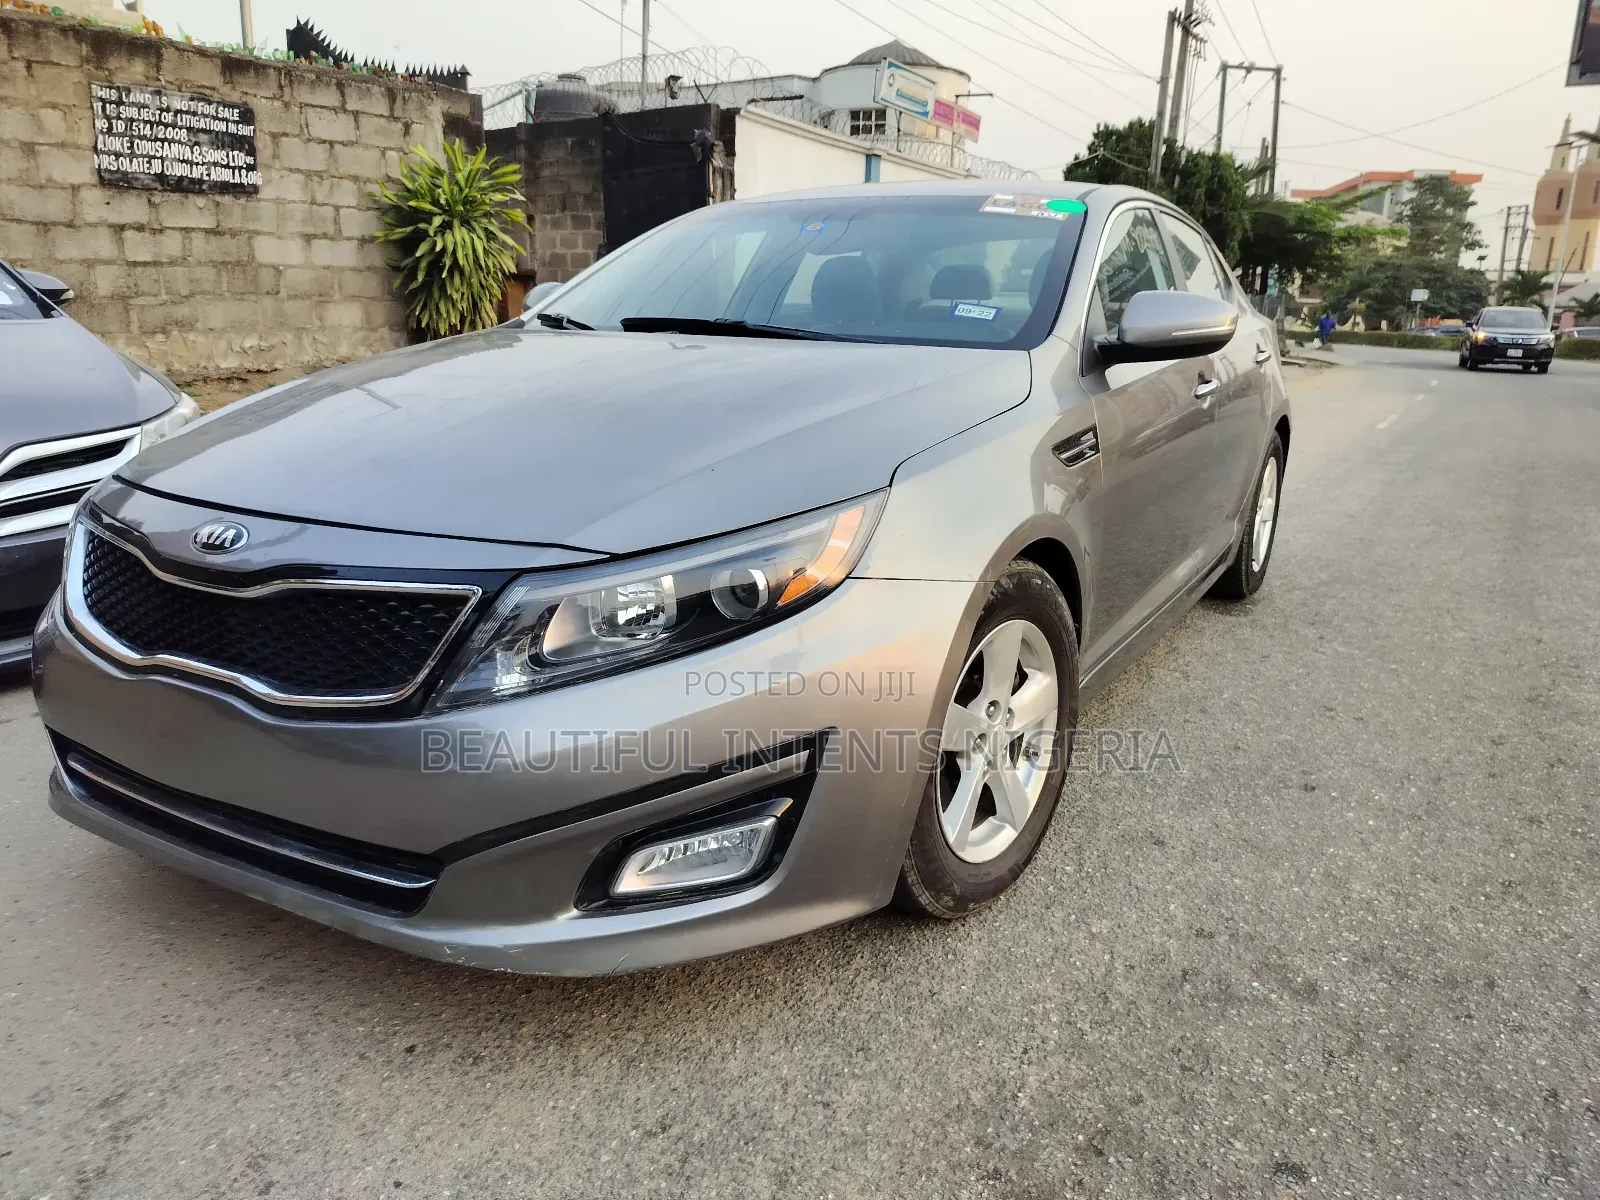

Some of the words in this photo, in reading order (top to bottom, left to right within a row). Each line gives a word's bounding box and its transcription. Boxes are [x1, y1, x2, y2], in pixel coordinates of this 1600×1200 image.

[91, 84, 118, 101] THIS
[122, 91, 153, 105] LAND
[198, 102, 217, 116] FOR
[217, 106, 240, 121] SALE
[93, 101, 103, 115] IT
[105, 103, 119, 117] IS
[119, 105, 160, 122] SUBJECT
[160, 111, 175, 124] OF
[177, 113, 227, 133] LITIGATION
[227, 121, 238, 134] IN
[237, 123, 255, 137] SUIT
[97, 133, 132, 154] AJOKE
[133, 138, 192, 161] ODUSANYA
[93, 153, 118, 171] MRS
[118, 156, 163, 174] OLATEJU
[163, 160, 209, 181] OJUOLAPE
[209, 165, 241, 184] ABIOLA
[196, 525, 237, 547] KIA
